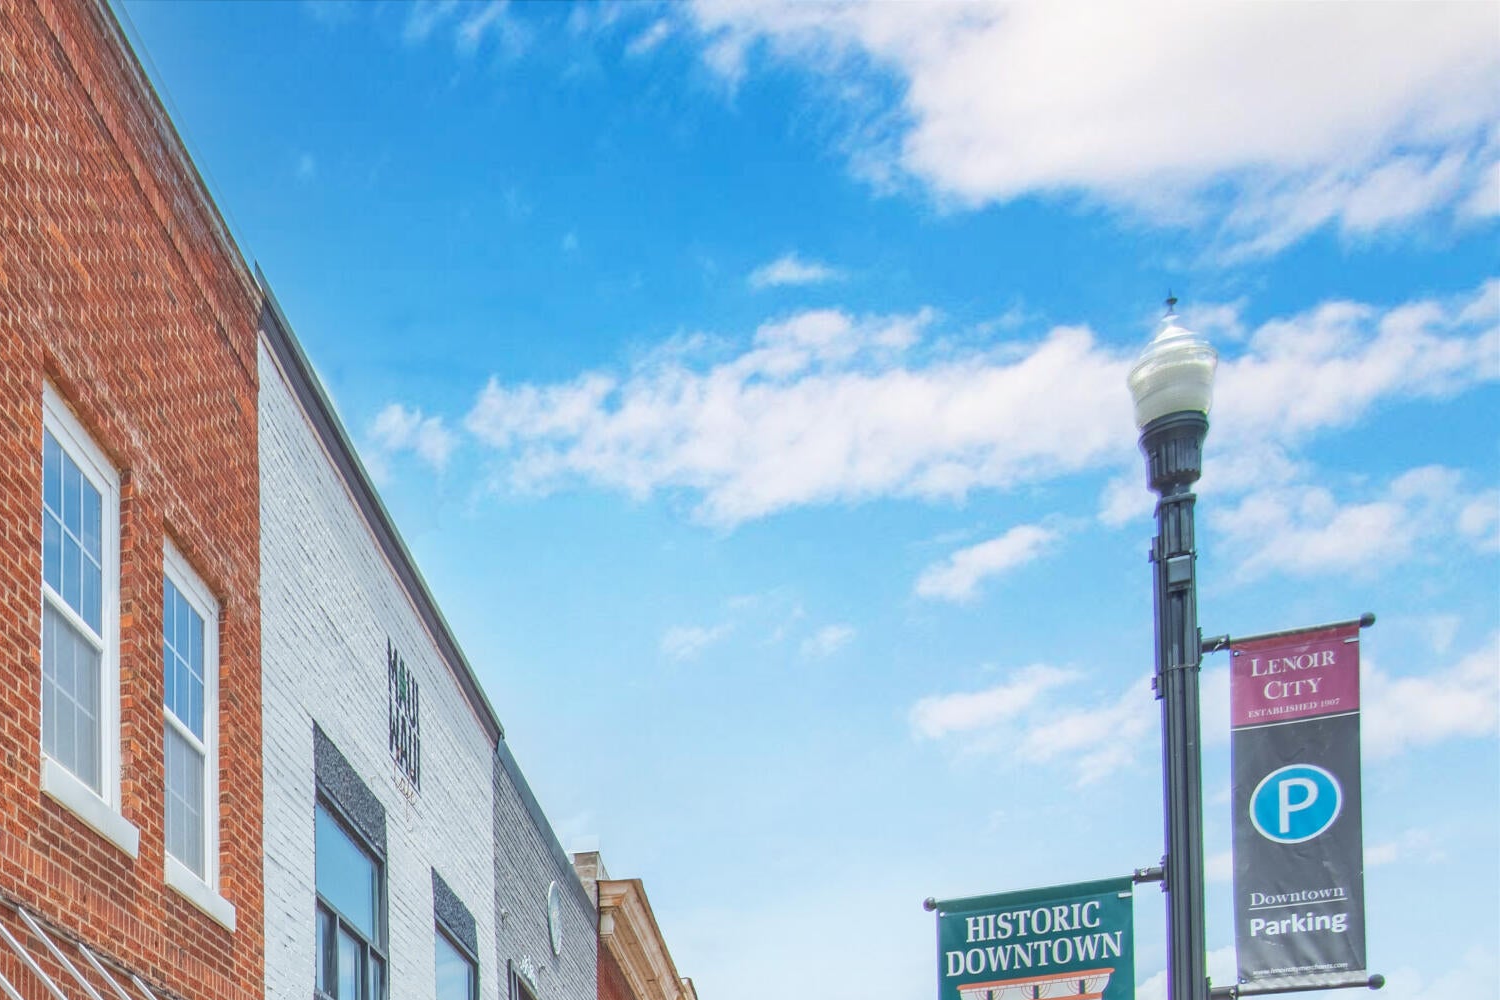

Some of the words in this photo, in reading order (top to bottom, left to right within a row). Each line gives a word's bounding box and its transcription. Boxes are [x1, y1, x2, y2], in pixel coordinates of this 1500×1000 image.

[1251, 650, 1336, 677] LENOIR
[1263, 677, 1323, 700] CITY
[1248, 701, 1318, 718] ESTABLISHED
[1250, 887, 1345, 906] Downtown
[965, 901, 1100, 943] HISTORIC
[1250, 912, 1348, 937] Parking
[946, 931, 1122, 977] DOWNTOWN
